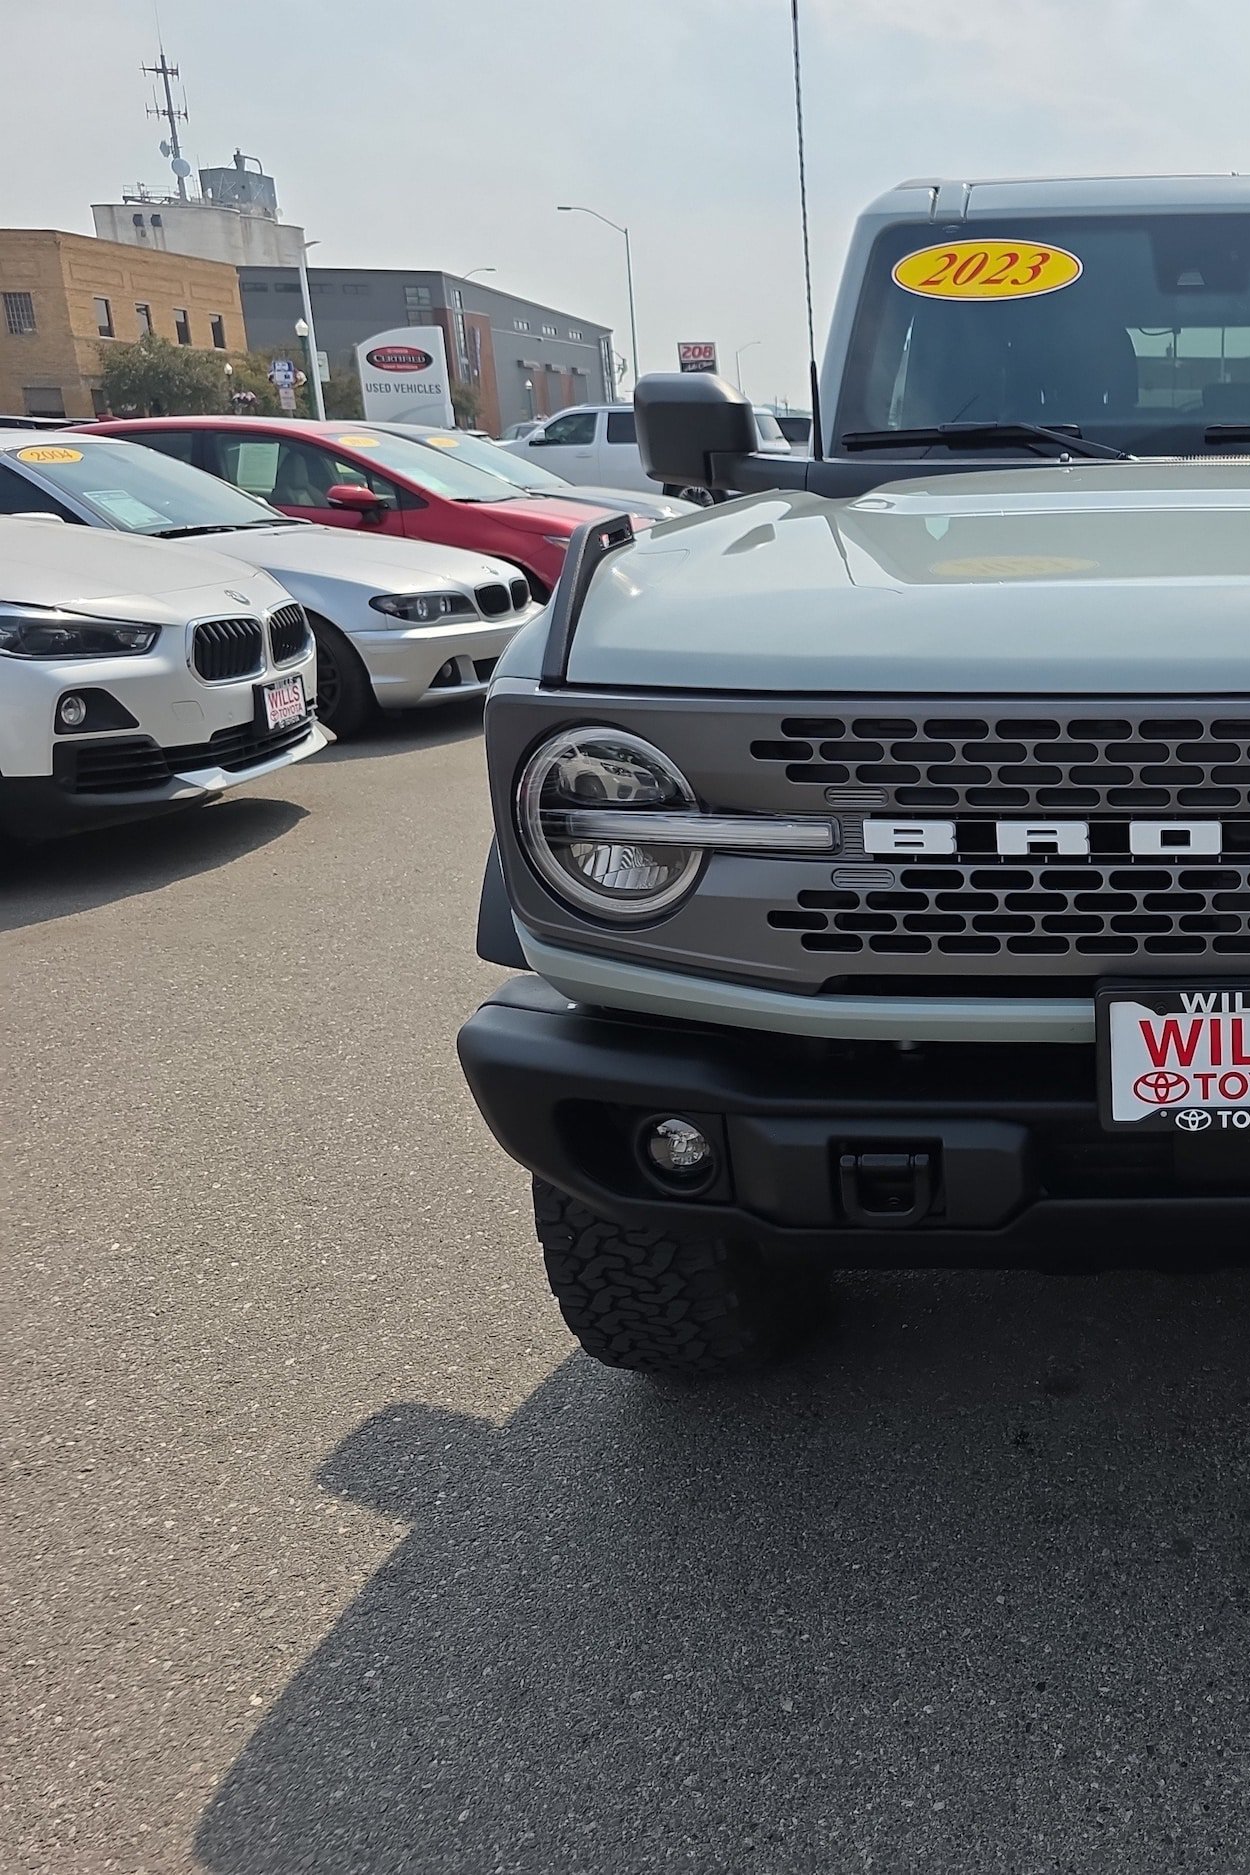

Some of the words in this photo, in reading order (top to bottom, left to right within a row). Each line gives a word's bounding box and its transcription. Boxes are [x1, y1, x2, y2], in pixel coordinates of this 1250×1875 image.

[918, 252, 1051, 287] 2023
[682, 346, 713, 358] 208
[366, 383, 391, 393] USED
[394, 383, 441, 394] VEHICLES
[30, 450, 74, 461] 2004
[268, 685, 300, 709] WILLS
[279, 703, 303, 718] TOYOTA
